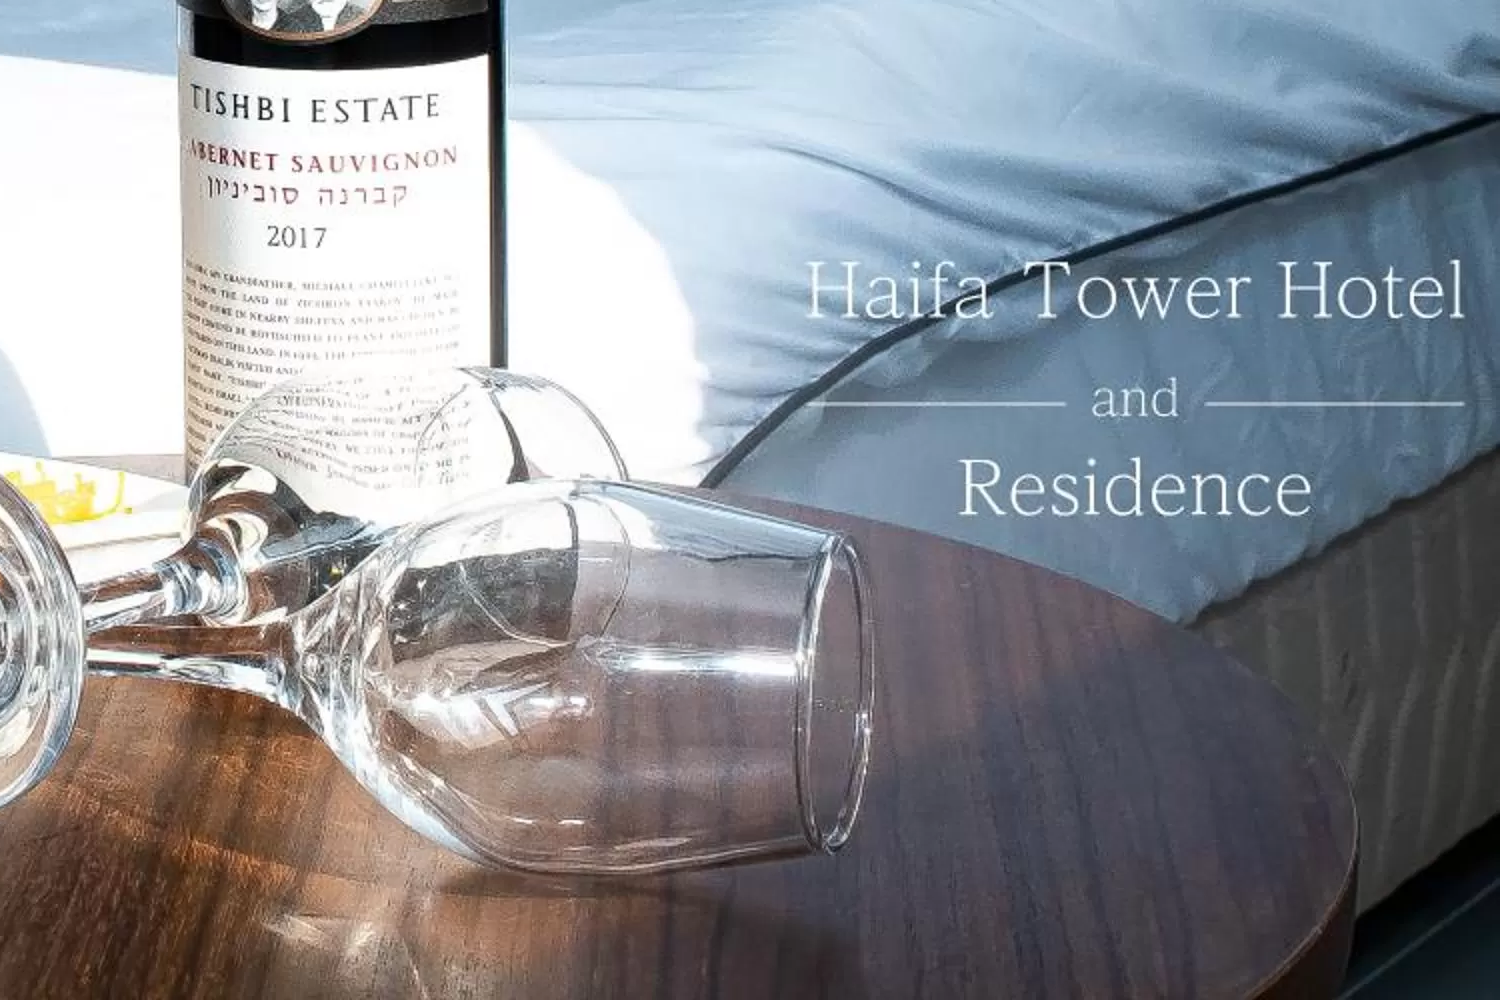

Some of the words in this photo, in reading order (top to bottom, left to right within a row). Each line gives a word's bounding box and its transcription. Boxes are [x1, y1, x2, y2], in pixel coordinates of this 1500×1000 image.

[189, 83, 292, 123] TISHBI
[310, 93, 440, 124] ESTATE
[186, 136, 280, 172] ABERNET
[291, 145, 458, 174] SAUVIGNON
[317, 185, 407, 208] קברנה
[267, 225, 327, 249] 2017
